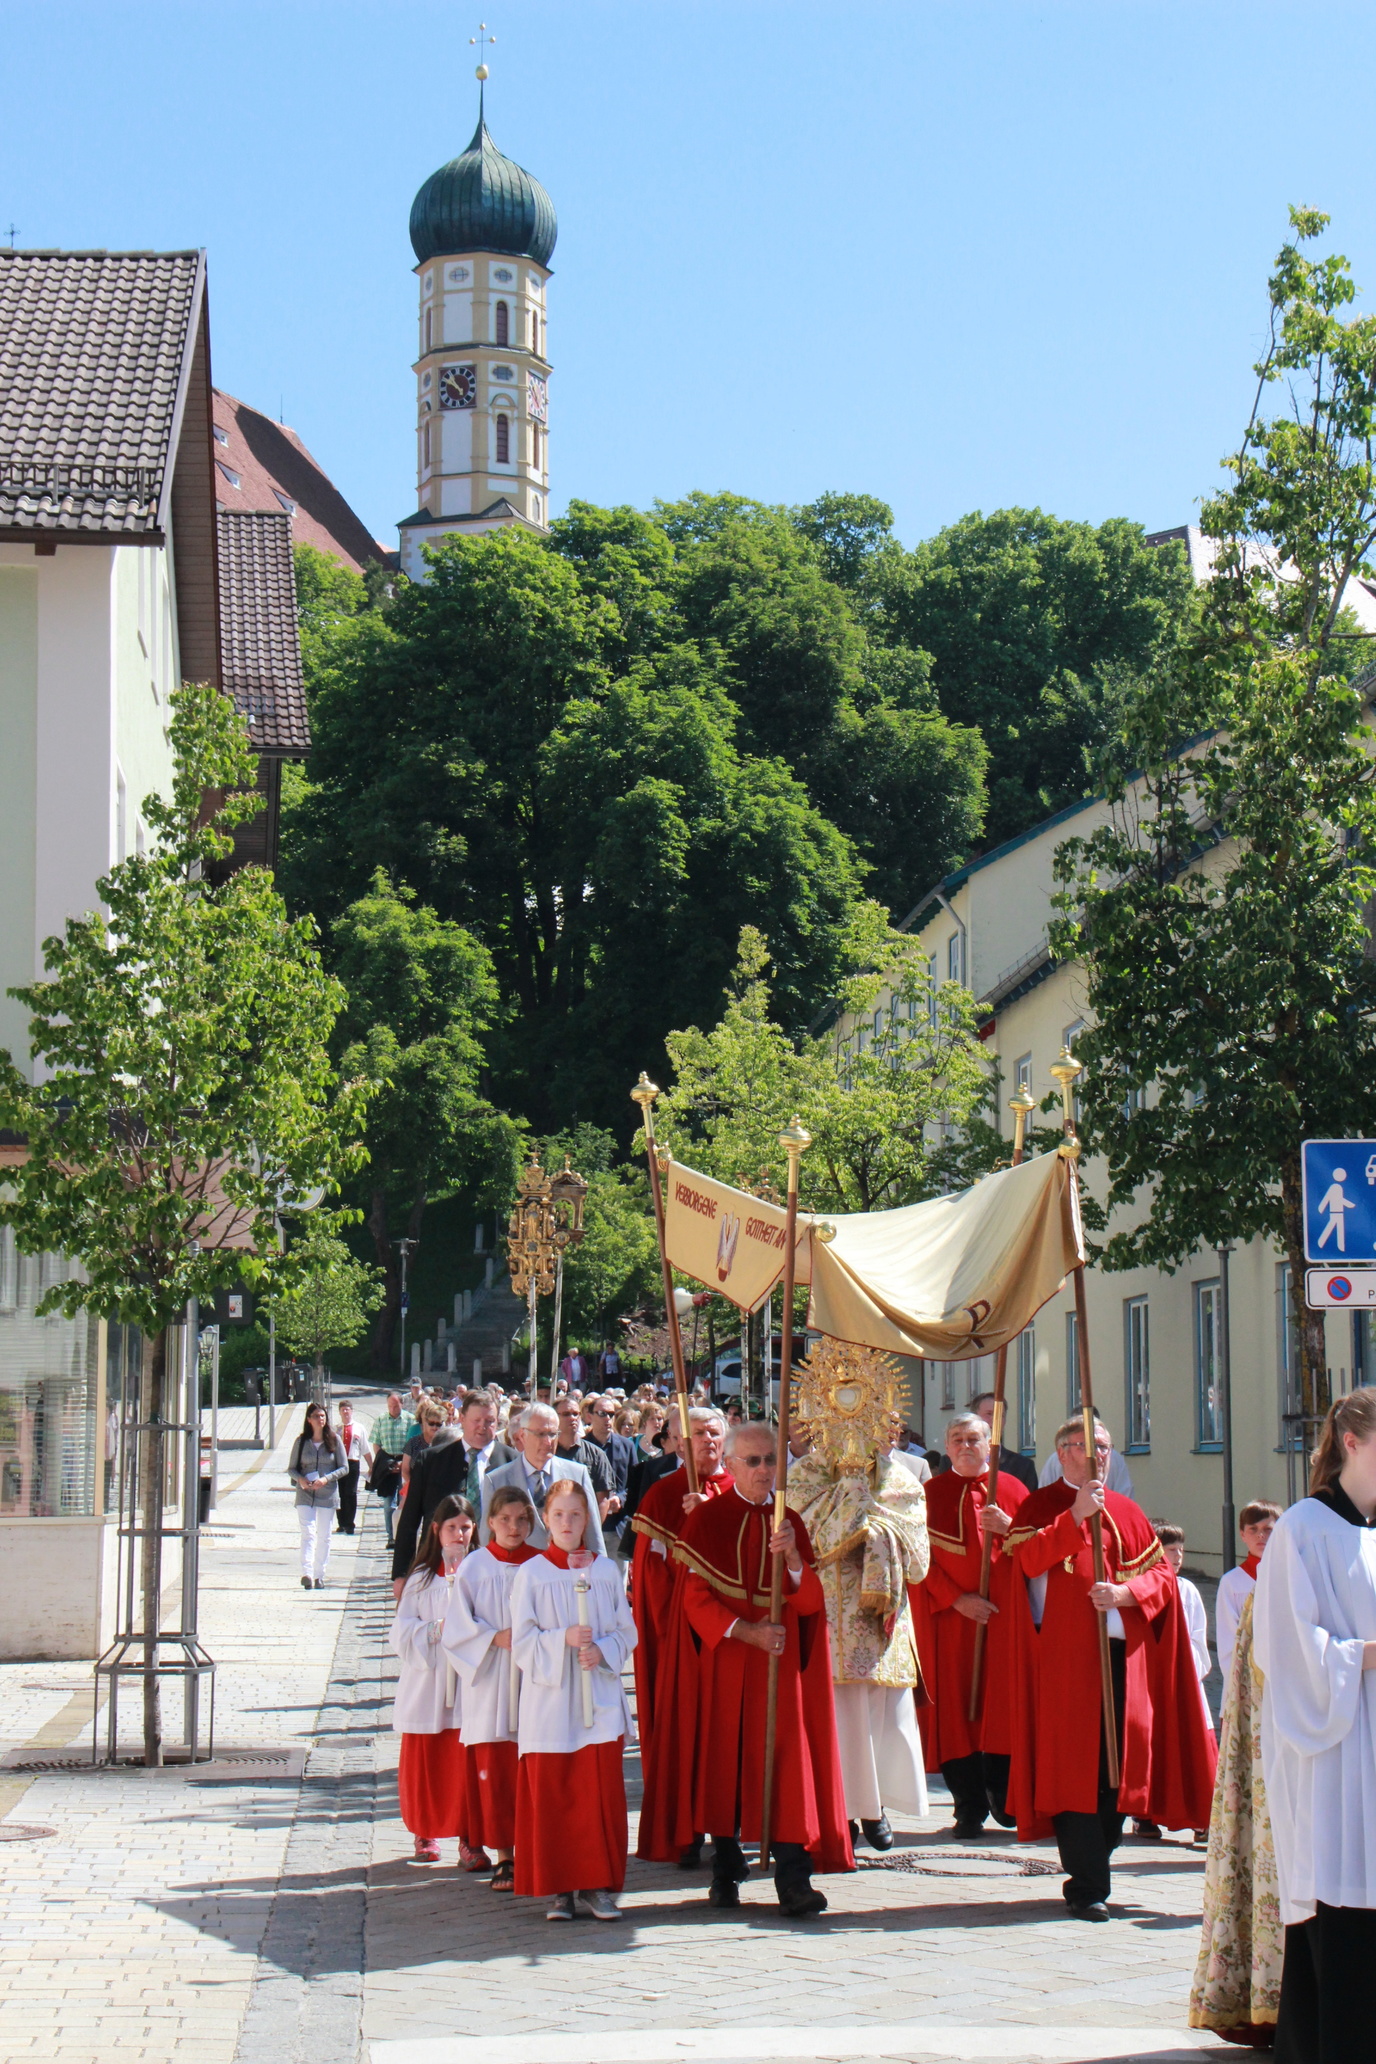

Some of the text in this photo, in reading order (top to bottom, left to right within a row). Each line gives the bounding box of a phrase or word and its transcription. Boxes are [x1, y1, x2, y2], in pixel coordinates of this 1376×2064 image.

[675, 1181, 718, 1220] VERBORGENE
[745, 1216, 779, 1245] GOTTHEIT
[1368, 1289, 1376, 1300] P
